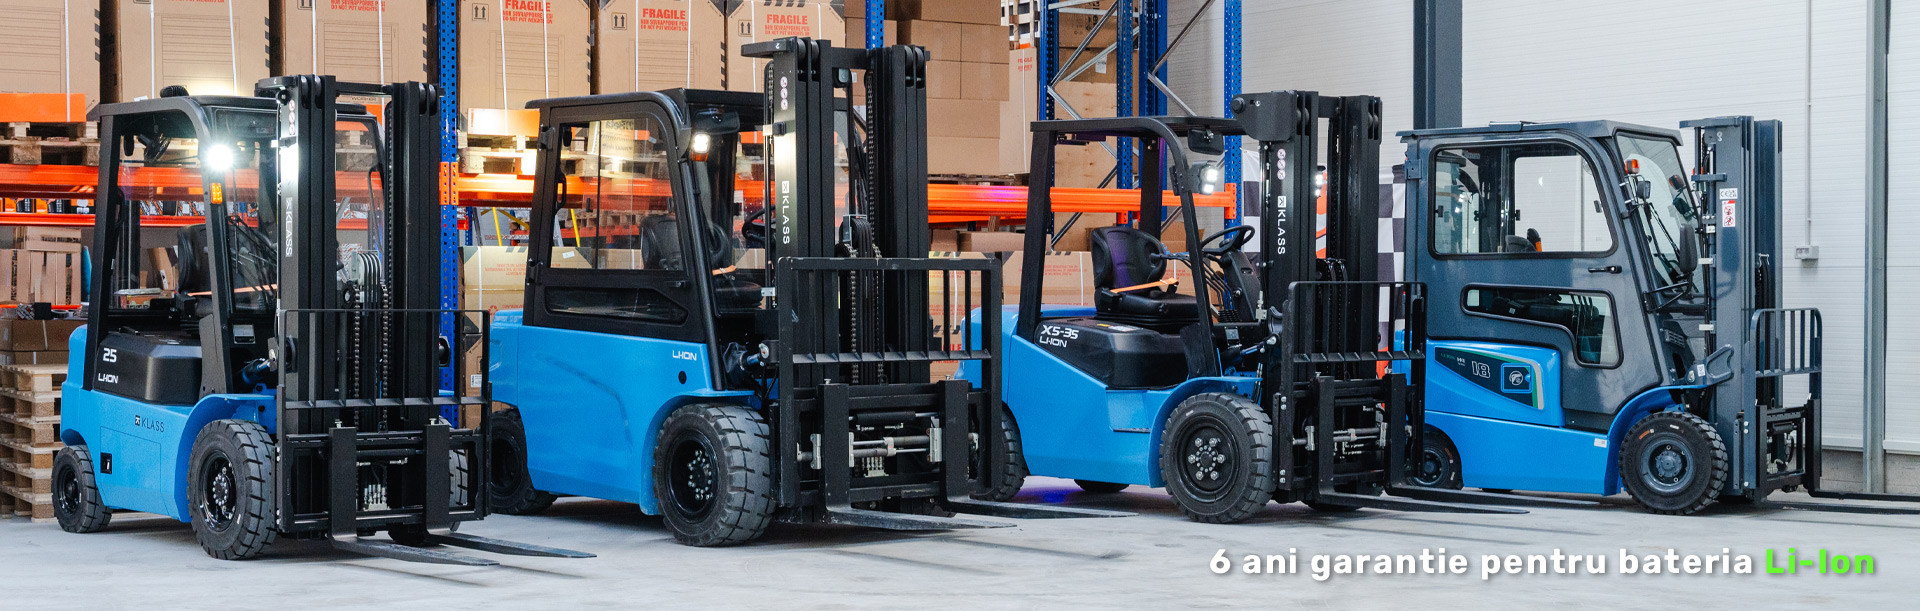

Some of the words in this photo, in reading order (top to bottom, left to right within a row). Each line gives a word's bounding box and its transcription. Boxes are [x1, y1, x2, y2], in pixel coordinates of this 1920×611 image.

[505, 0, 551, 12] FRAGILE
[643, 8, 686, 19] FRAGILE
[766, 14, 808, 24] FRAGILE
[782, 195, 790, 245] KLASS
[285, 211, 293, 257] KLASS
[1277, 209, 1286, 255] KLASS
[102, 347, 117, 363] 25
[1471, 360, 1491, 378] 18
[141, 417, 165, 433] KLASS
